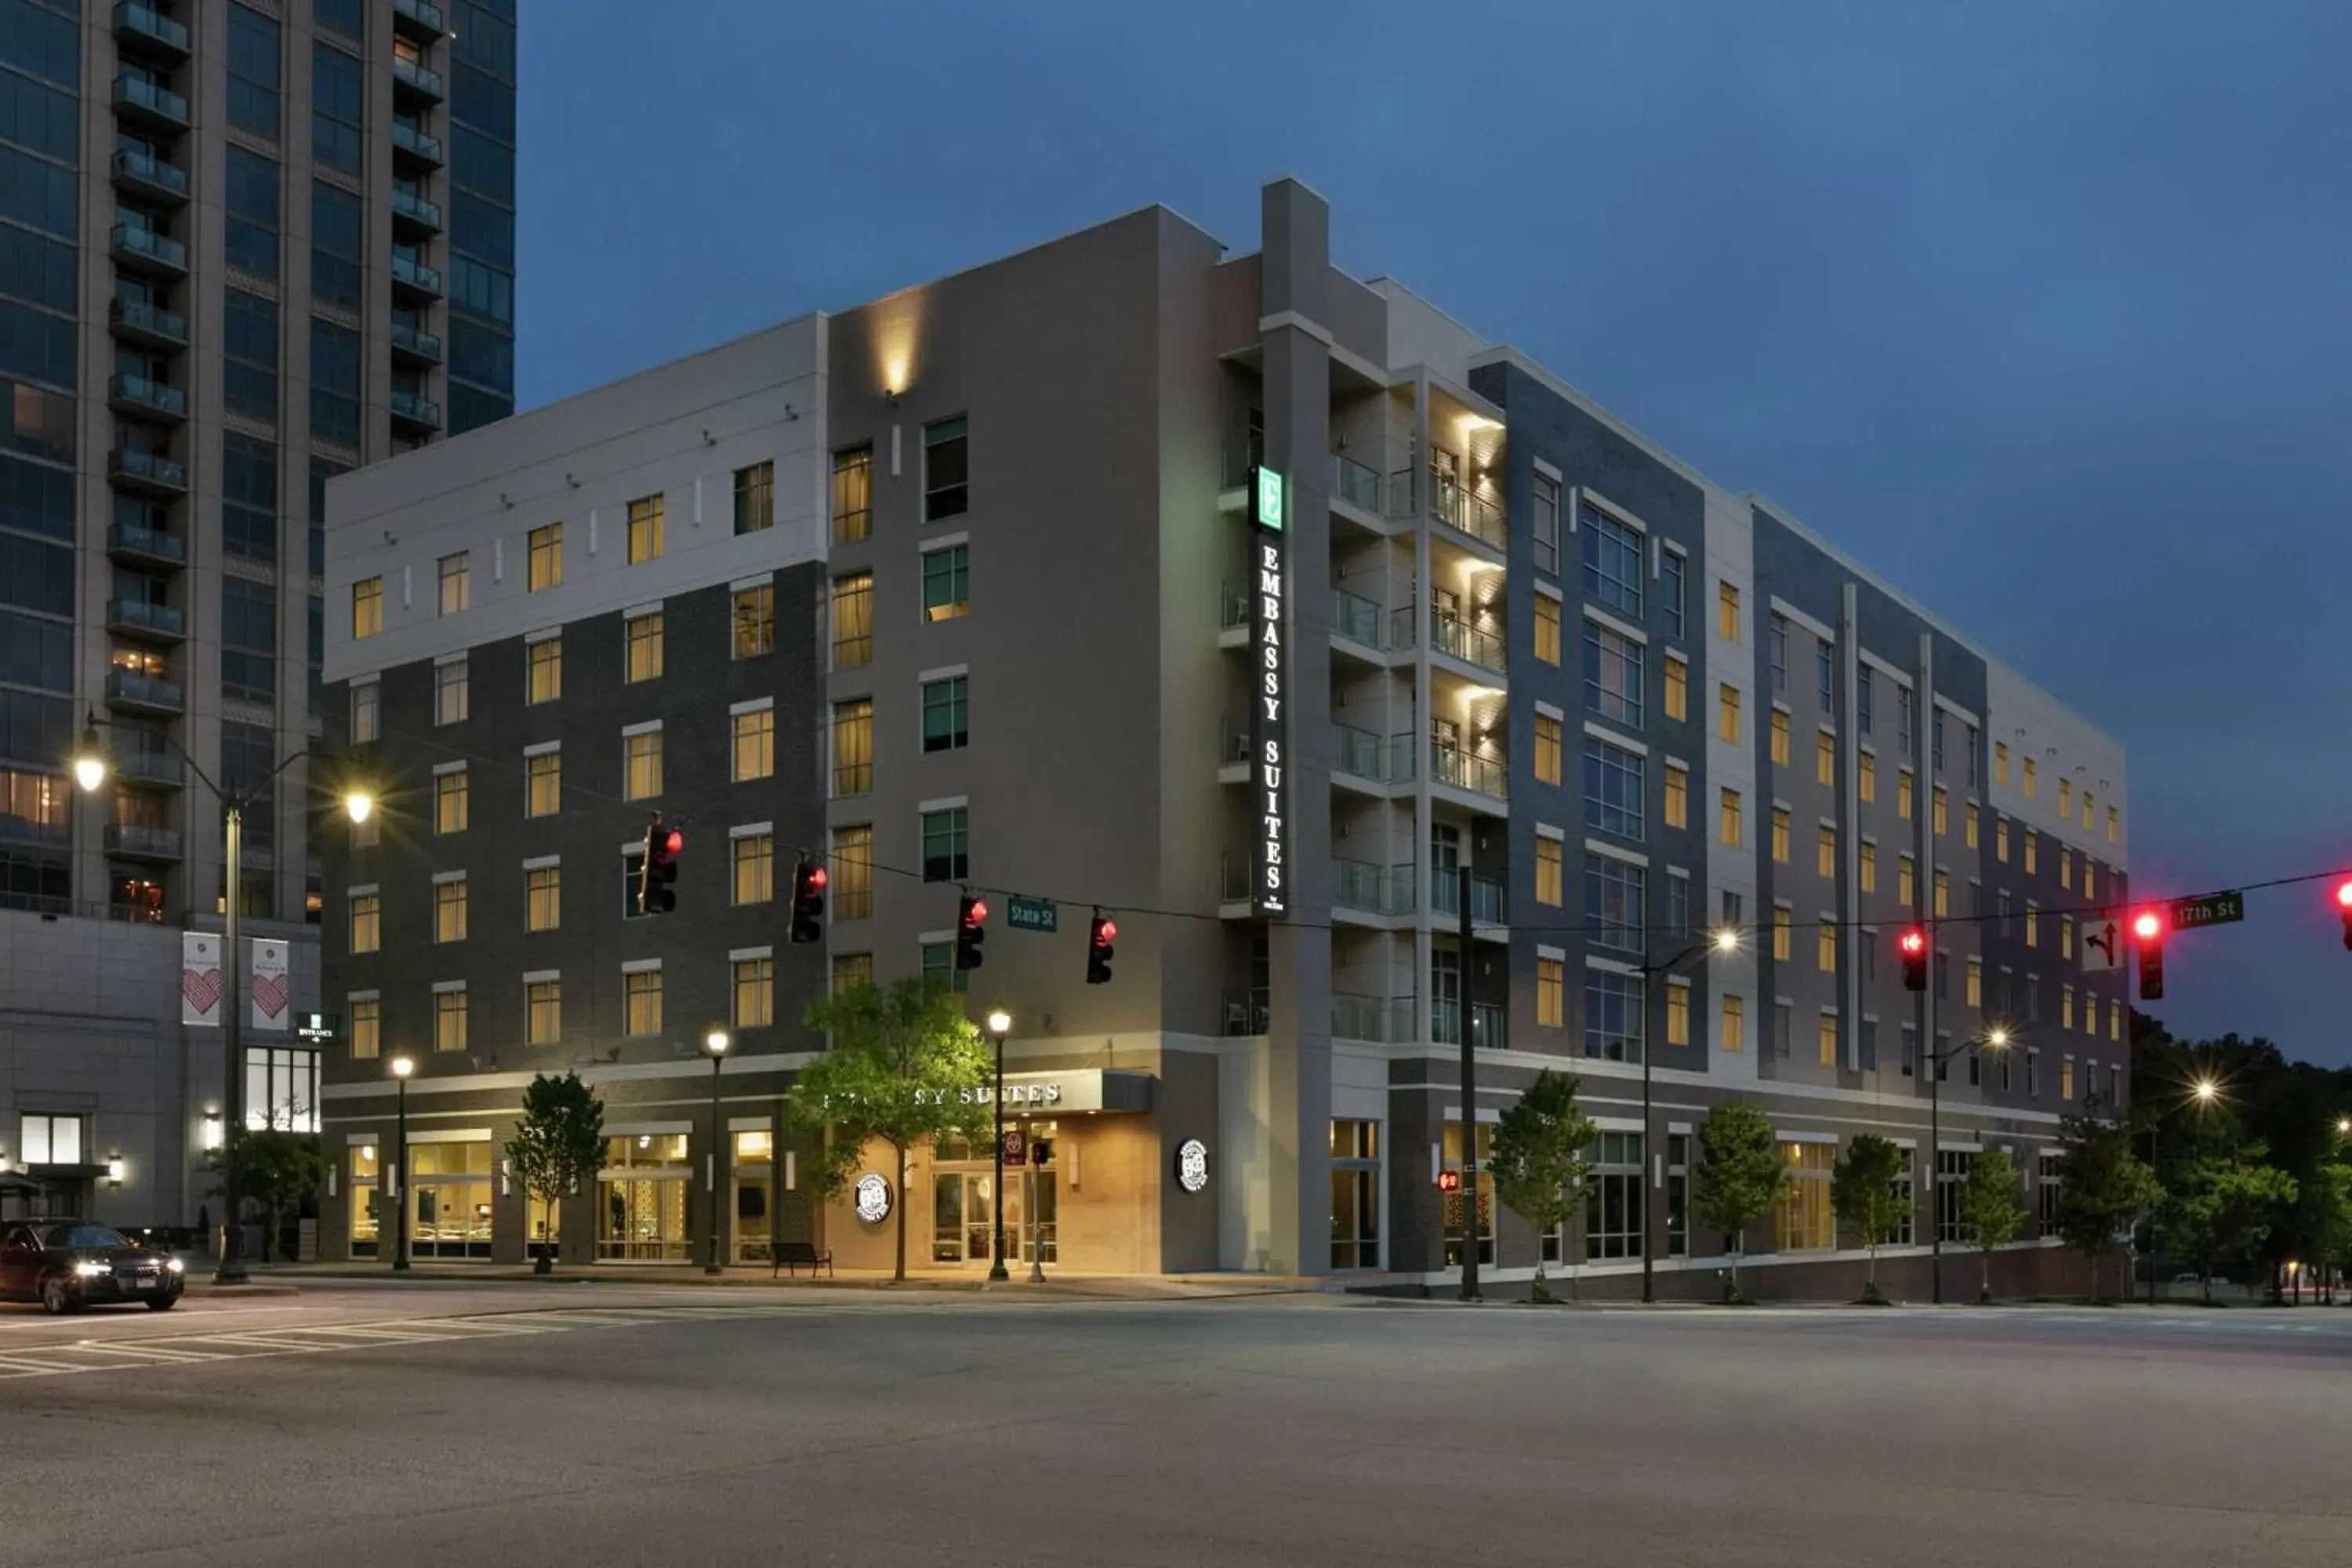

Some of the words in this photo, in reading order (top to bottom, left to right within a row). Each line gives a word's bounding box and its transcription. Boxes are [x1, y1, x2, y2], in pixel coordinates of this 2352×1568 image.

[1261, 546, 1280, 720] EMBASSY
[1263, 741, 1281, 888] SUITES
[1011, 906, 1040, 924] State
[1042, 909, 1053, 925] St
[2180, 905, 2212, 924] 17th
[2218, 902, 2235, 916] St
[959, 1083, 1059, 1104] SUTES
